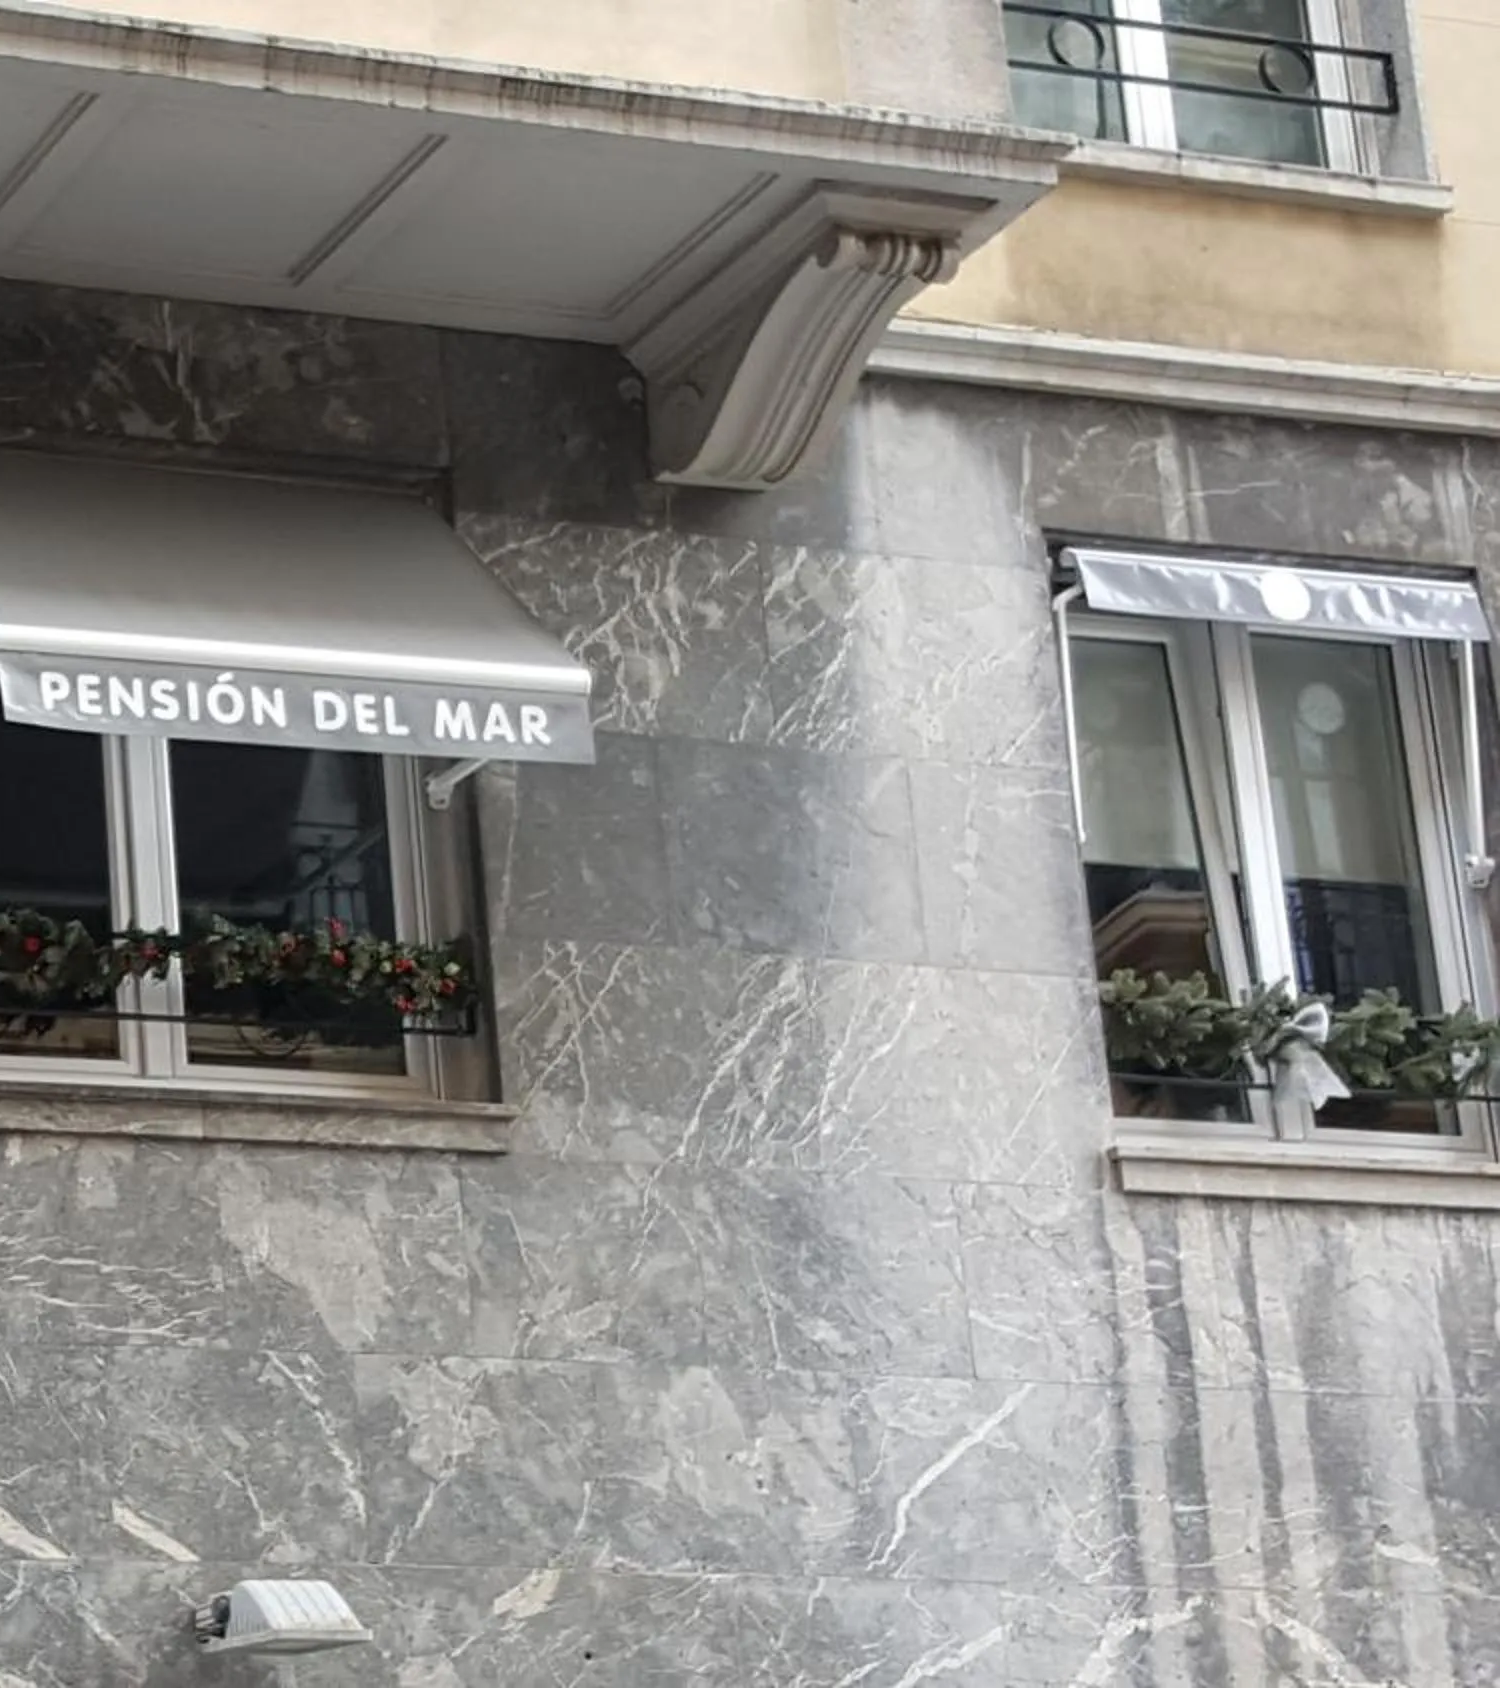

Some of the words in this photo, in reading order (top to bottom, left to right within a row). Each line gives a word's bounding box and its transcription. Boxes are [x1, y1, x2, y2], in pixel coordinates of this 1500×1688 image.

[39, 672, 287, 728] PENSIÓN
[313, 690, 410, 737] DEL
[434, 698, 552, 745] MAR
